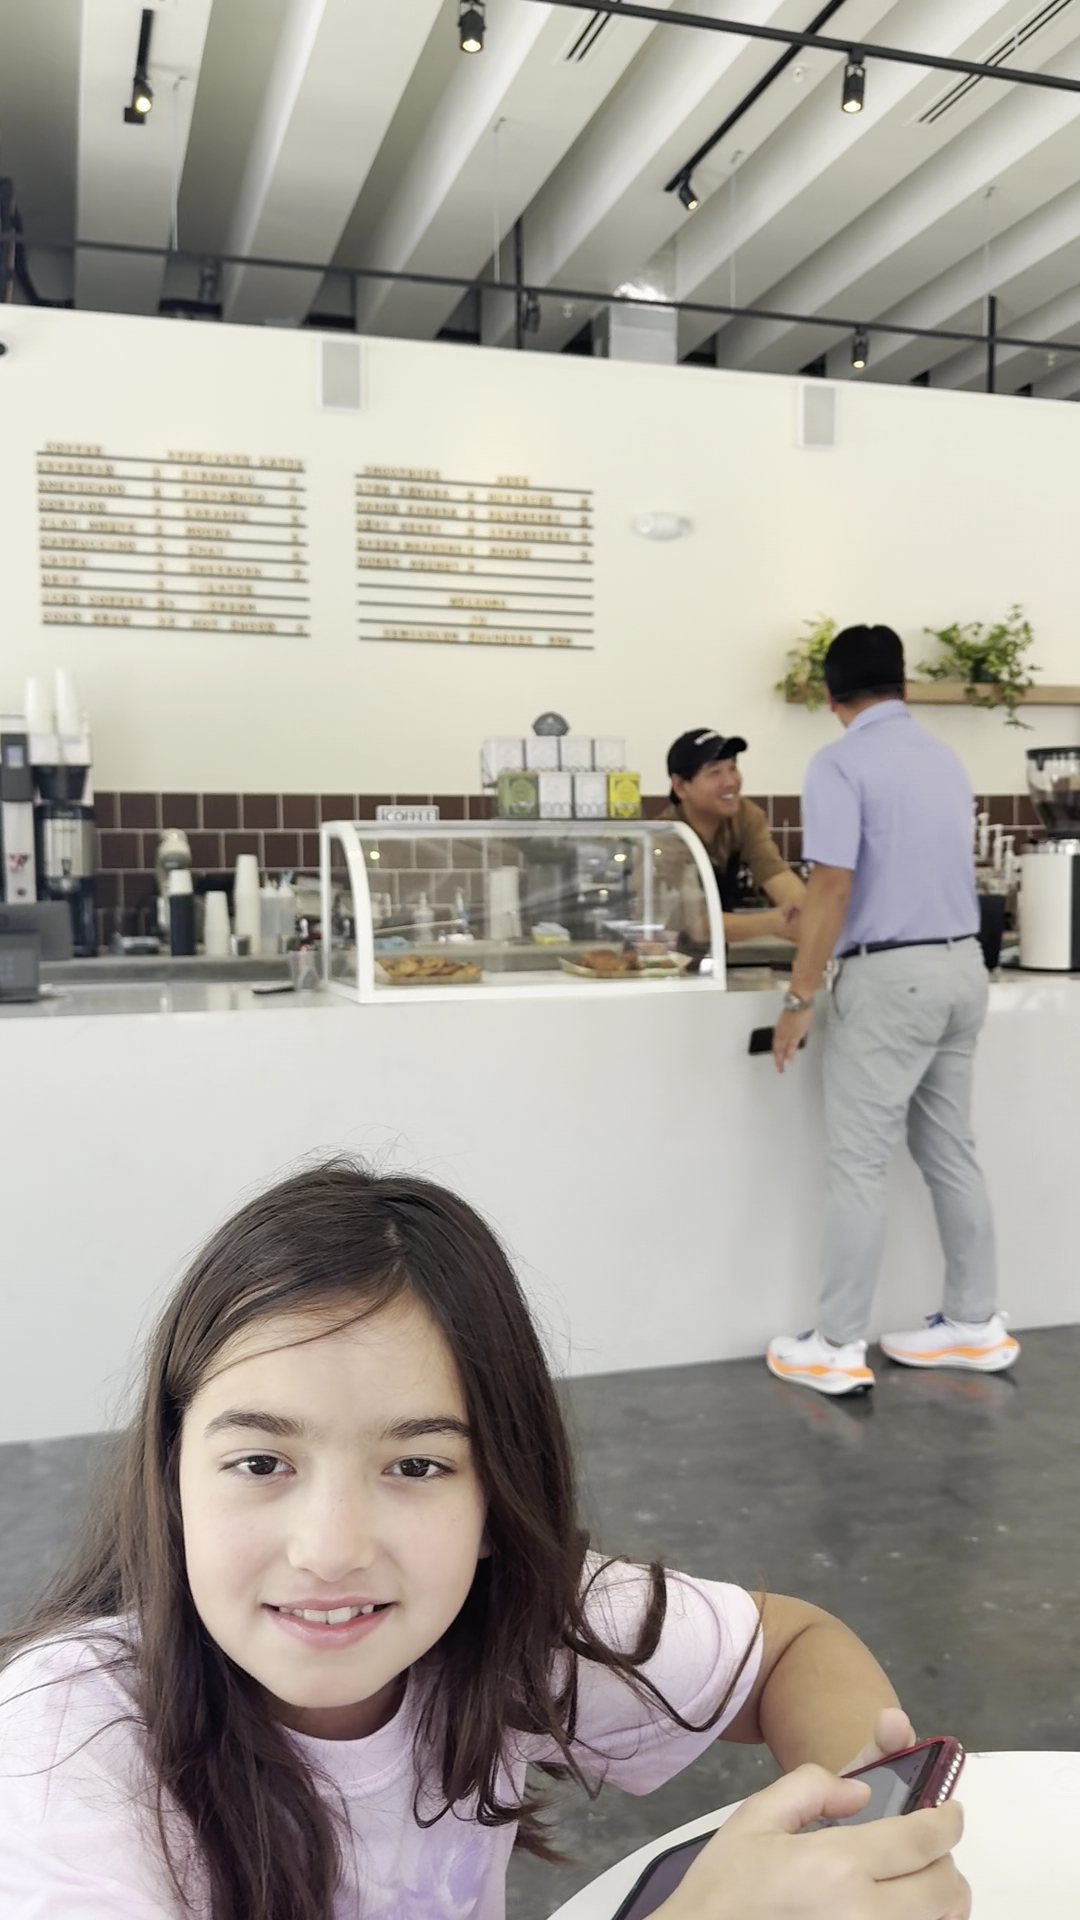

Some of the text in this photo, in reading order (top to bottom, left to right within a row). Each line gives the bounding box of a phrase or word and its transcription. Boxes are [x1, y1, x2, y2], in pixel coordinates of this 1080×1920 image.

[45, 442, 102, 455] COFFEE
[38, 462, 114, 475] ESPRESSO
[38, 481, 126, 494] AMERICANO
[39, 499, 106, 512] CORTADO
[89, 520, 134, 533] WHITE
[186, 526, 231, 537] MOCHA
[40, 537, 136, 550] CAPPUCCINO
[188, 545, 223, 555] CHAI
[41, 556, 86, 567] LATTE
[42, 574, 78, 586] DRIP
[43, 593, 80, 605] ICED
[89, 595, 144, 608] COFFEE
[43, 612, 81, 624] COLD
[191, 618, 218, 629] HOT
